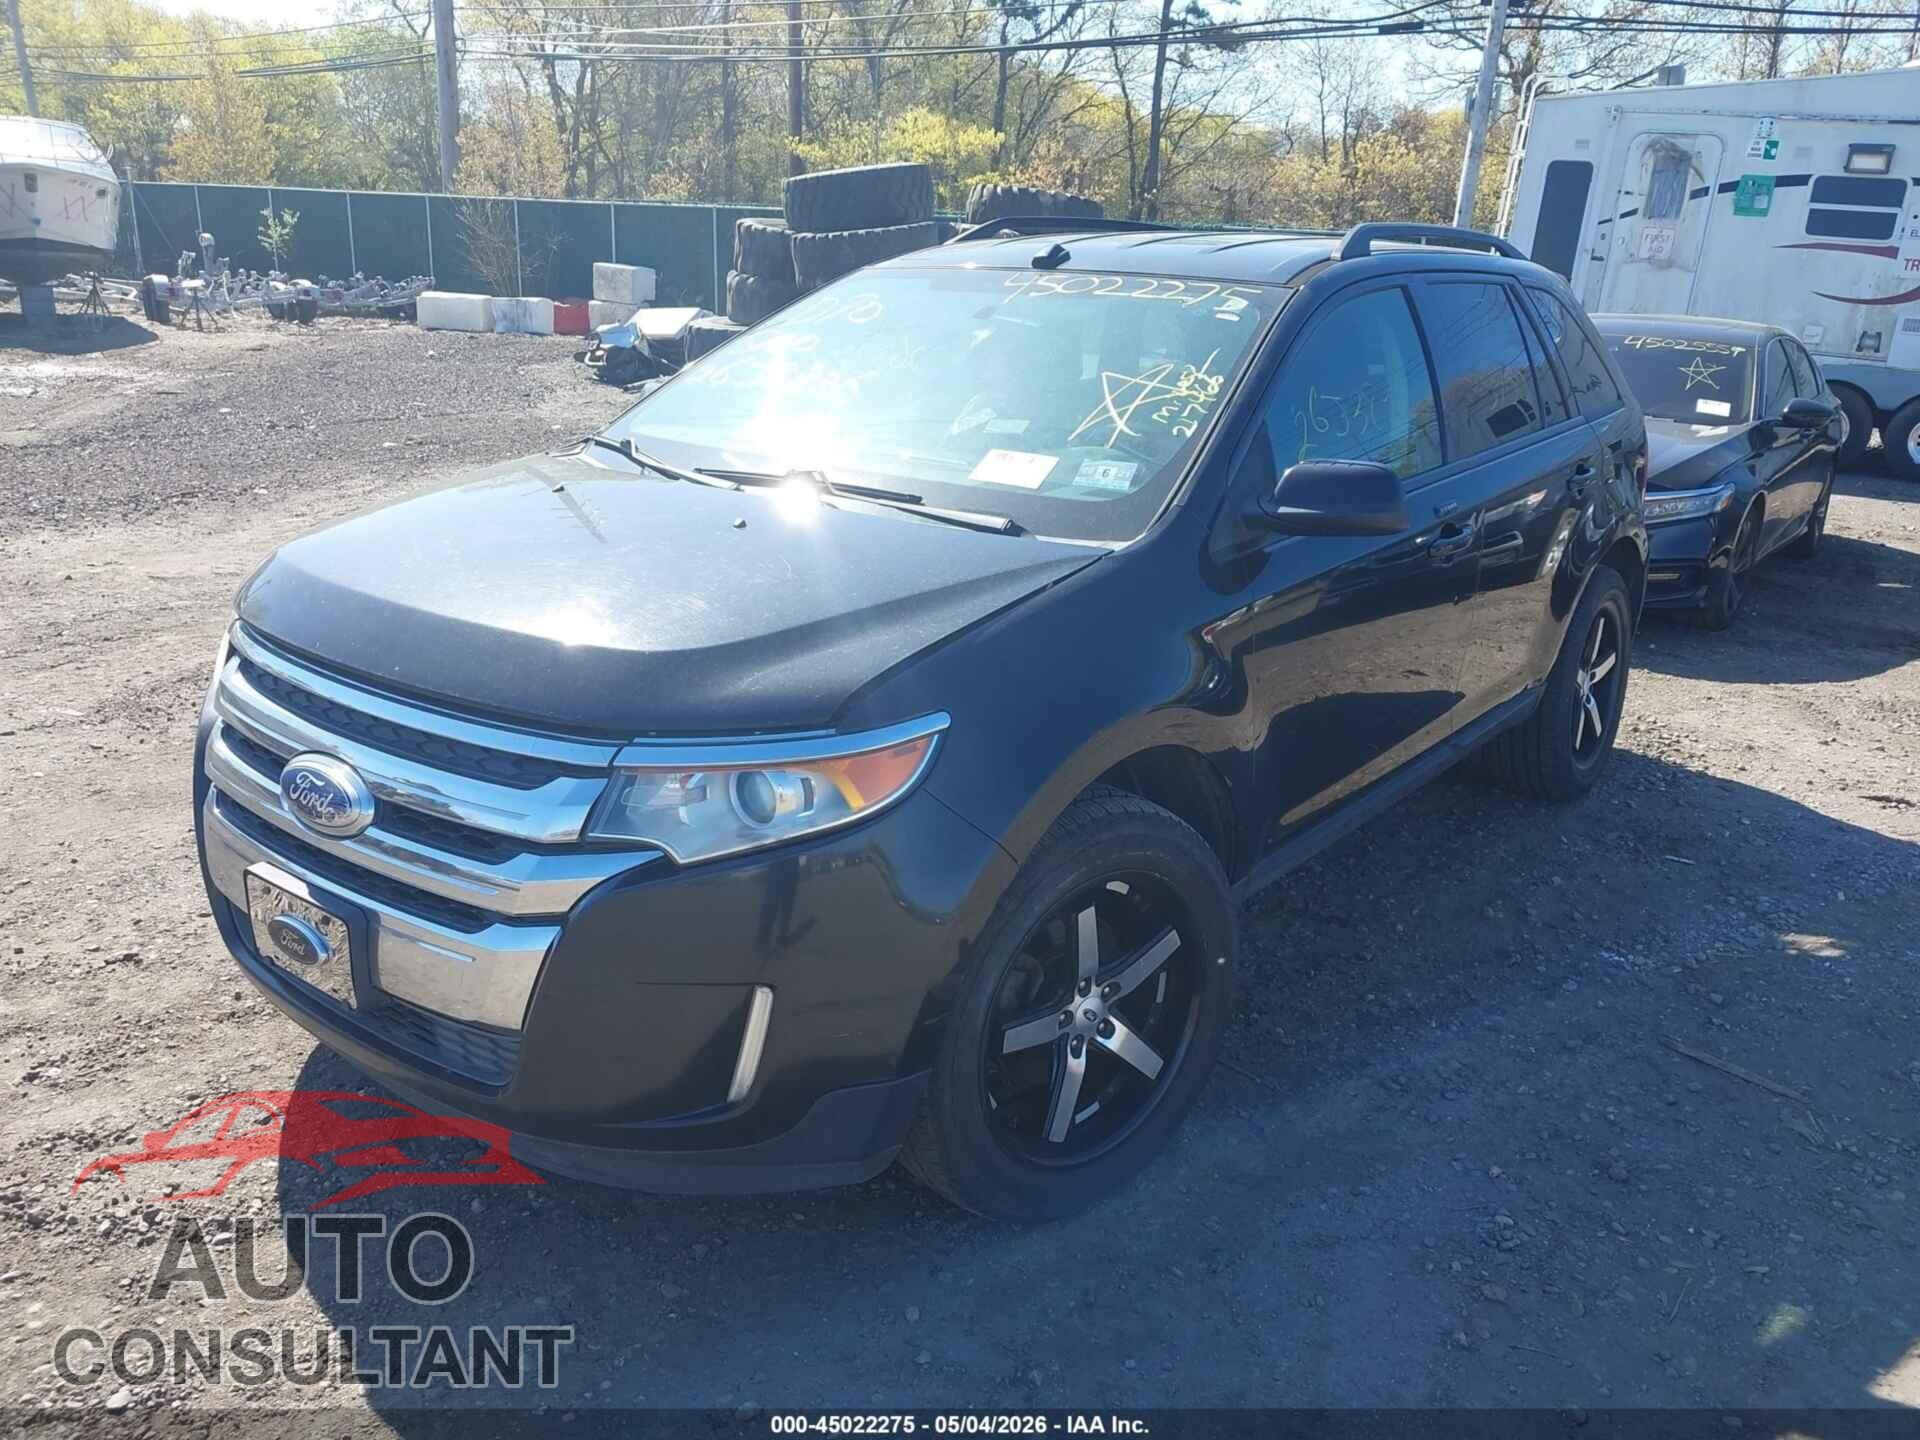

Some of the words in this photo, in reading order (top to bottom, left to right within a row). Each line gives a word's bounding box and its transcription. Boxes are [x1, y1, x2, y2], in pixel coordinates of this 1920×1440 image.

[1645, 233, 1672, 242] FIRST
[1648, 246, 1665, 255] AID
[1003, 271, 1262, 314] 45022275
[289, 771, 337, 818] Ford
[280, 928, 305, 956] Ford
